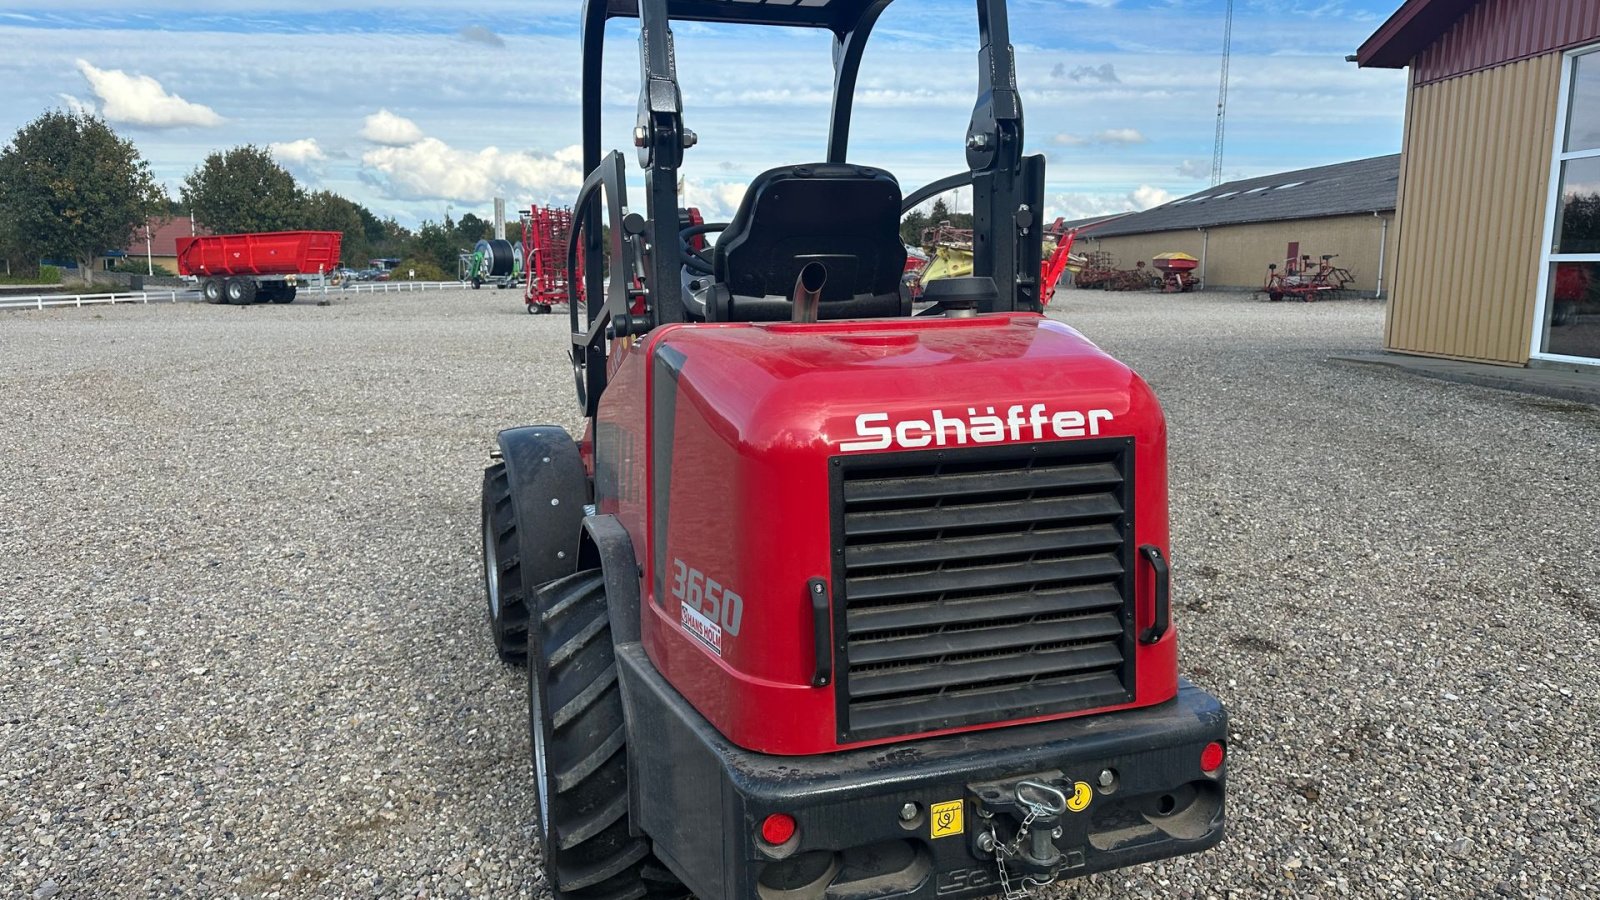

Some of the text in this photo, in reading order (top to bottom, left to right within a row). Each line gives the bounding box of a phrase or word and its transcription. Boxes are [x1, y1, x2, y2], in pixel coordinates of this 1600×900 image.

[840, 403, 1114, 452] Schäffer
[671, 557, 743, 637] 3650
[687, 613, 704, 635] HANS
[704, 624, 721, 649] HOLM
